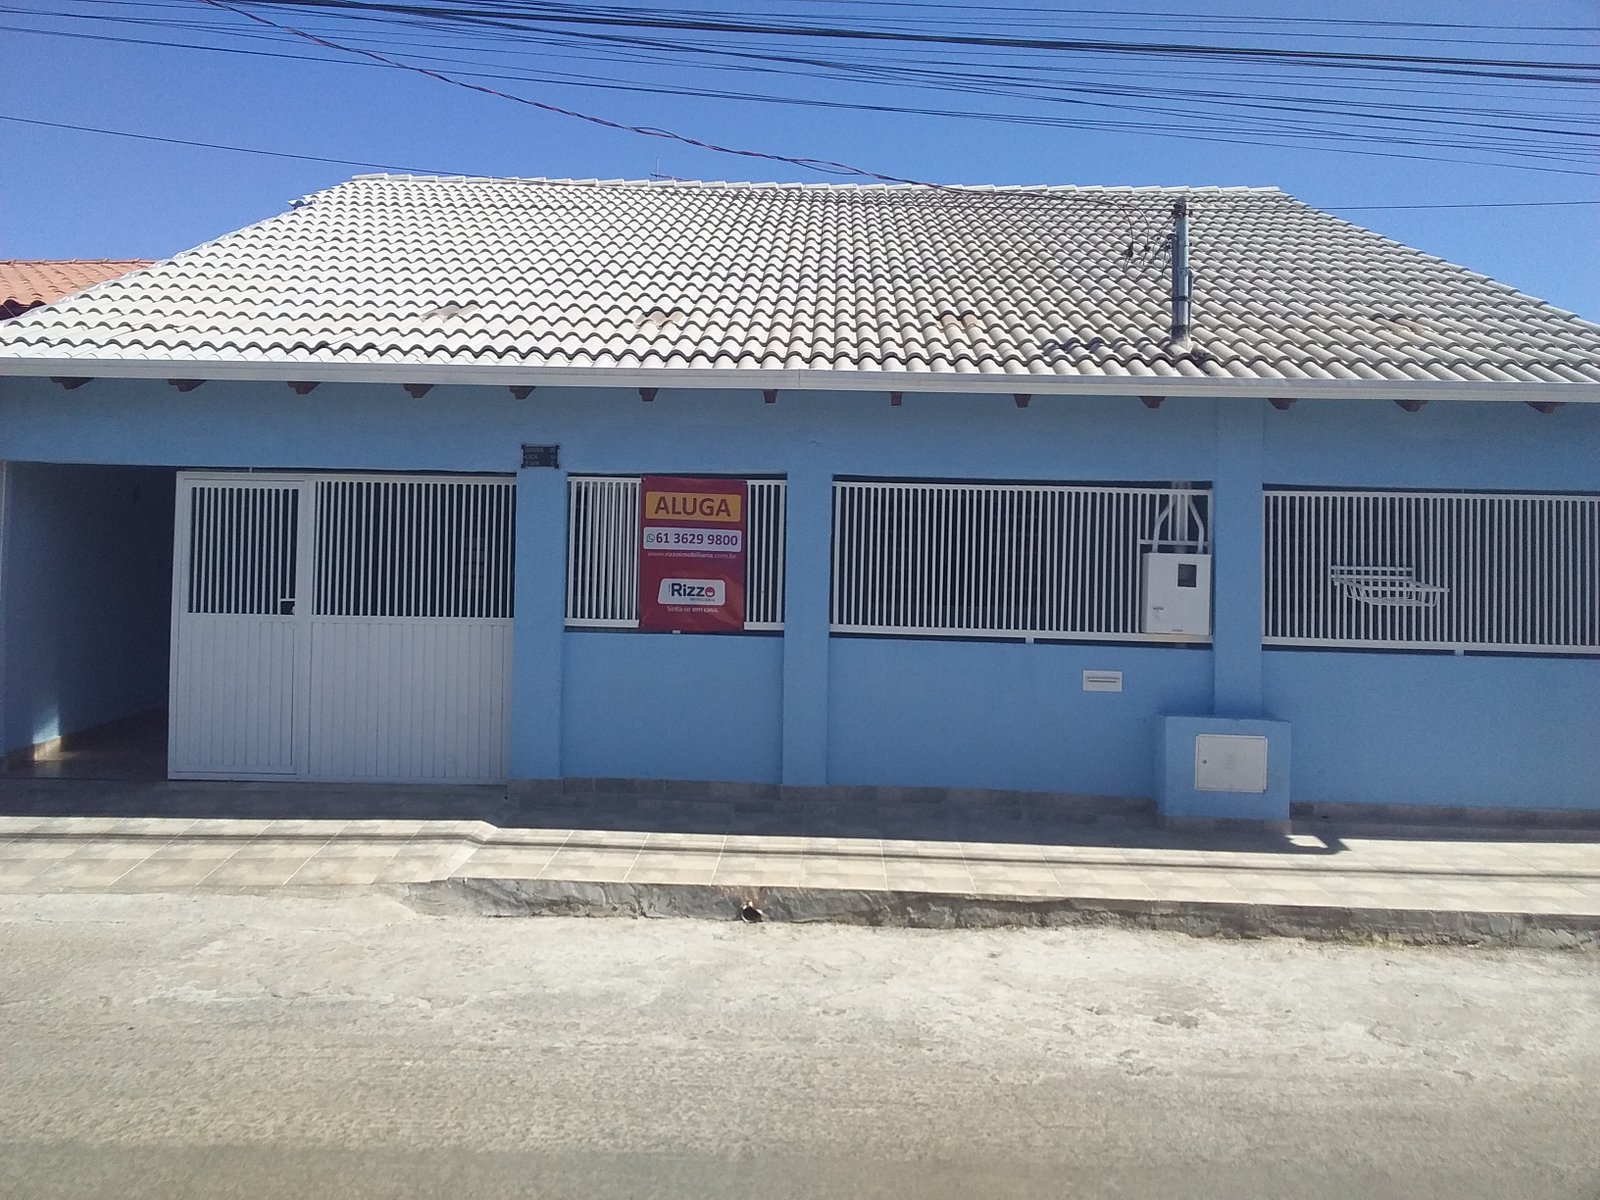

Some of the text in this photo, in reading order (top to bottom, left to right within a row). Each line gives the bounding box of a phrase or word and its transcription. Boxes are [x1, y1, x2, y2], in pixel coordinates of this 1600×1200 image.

[654, 495, 732, 517] ALUGA
[656, 532, 738, 546] 61 3629 9800
[671, 582, 716, 598] Rizzo
